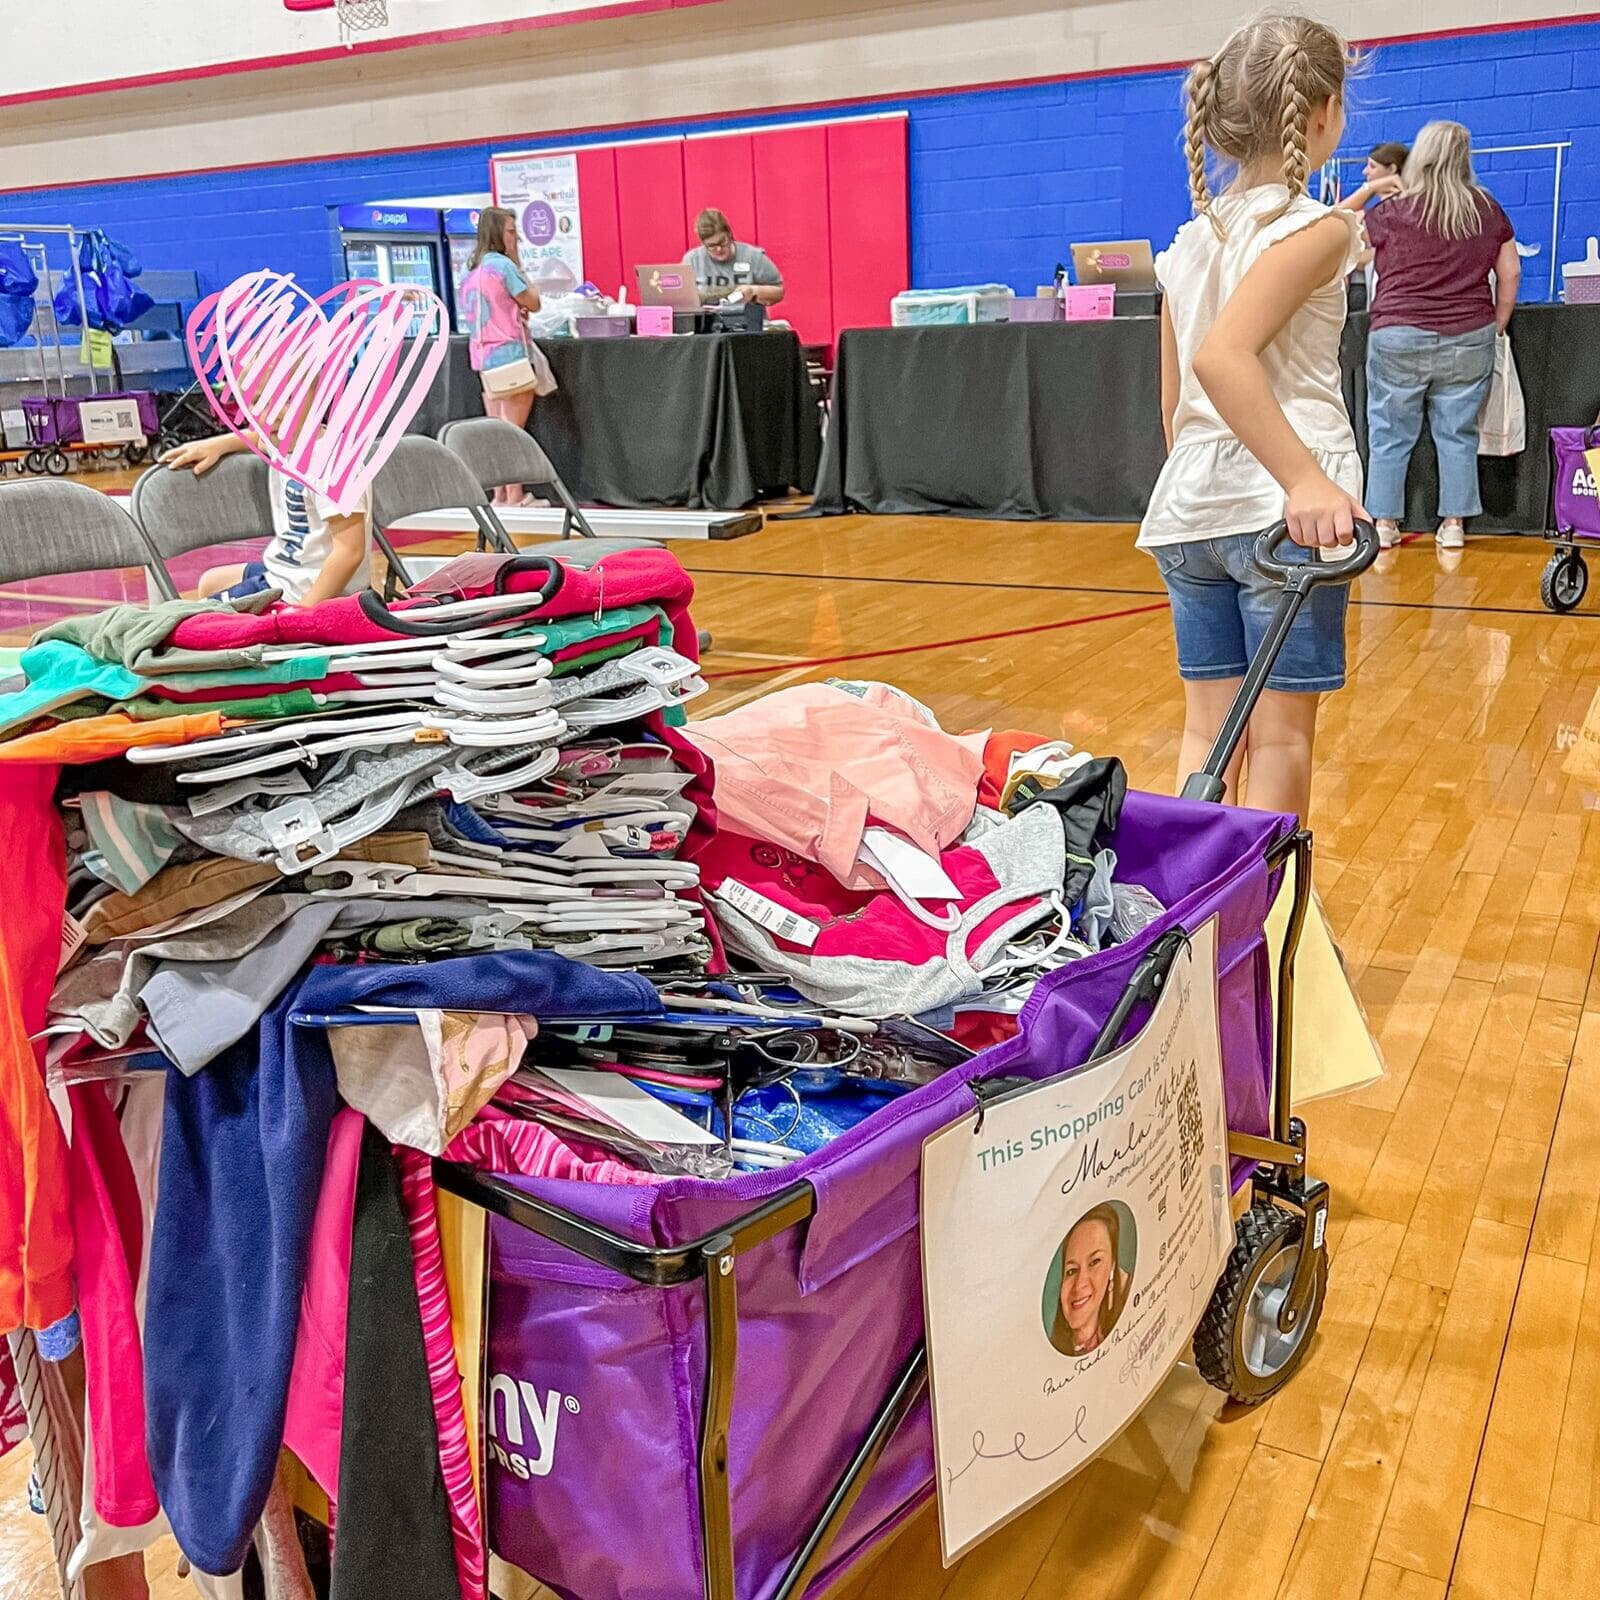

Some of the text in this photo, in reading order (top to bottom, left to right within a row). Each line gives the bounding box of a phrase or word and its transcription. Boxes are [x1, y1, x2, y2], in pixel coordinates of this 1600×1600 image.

[382, 212, 408, 226] pepsi
[977, 1140, 1024, 1172] This
[1029, 1094, 1124, 1151] Shopping
[1128, 1066, 1152, 1100] Cart
[1153, 1055, 1160, 1075] is
[1061, 1121, 1152, 1194] Marla
[1043, 1376, 1073, 1397] Fair
[1073, 1348, 1110, 1376] Trade
